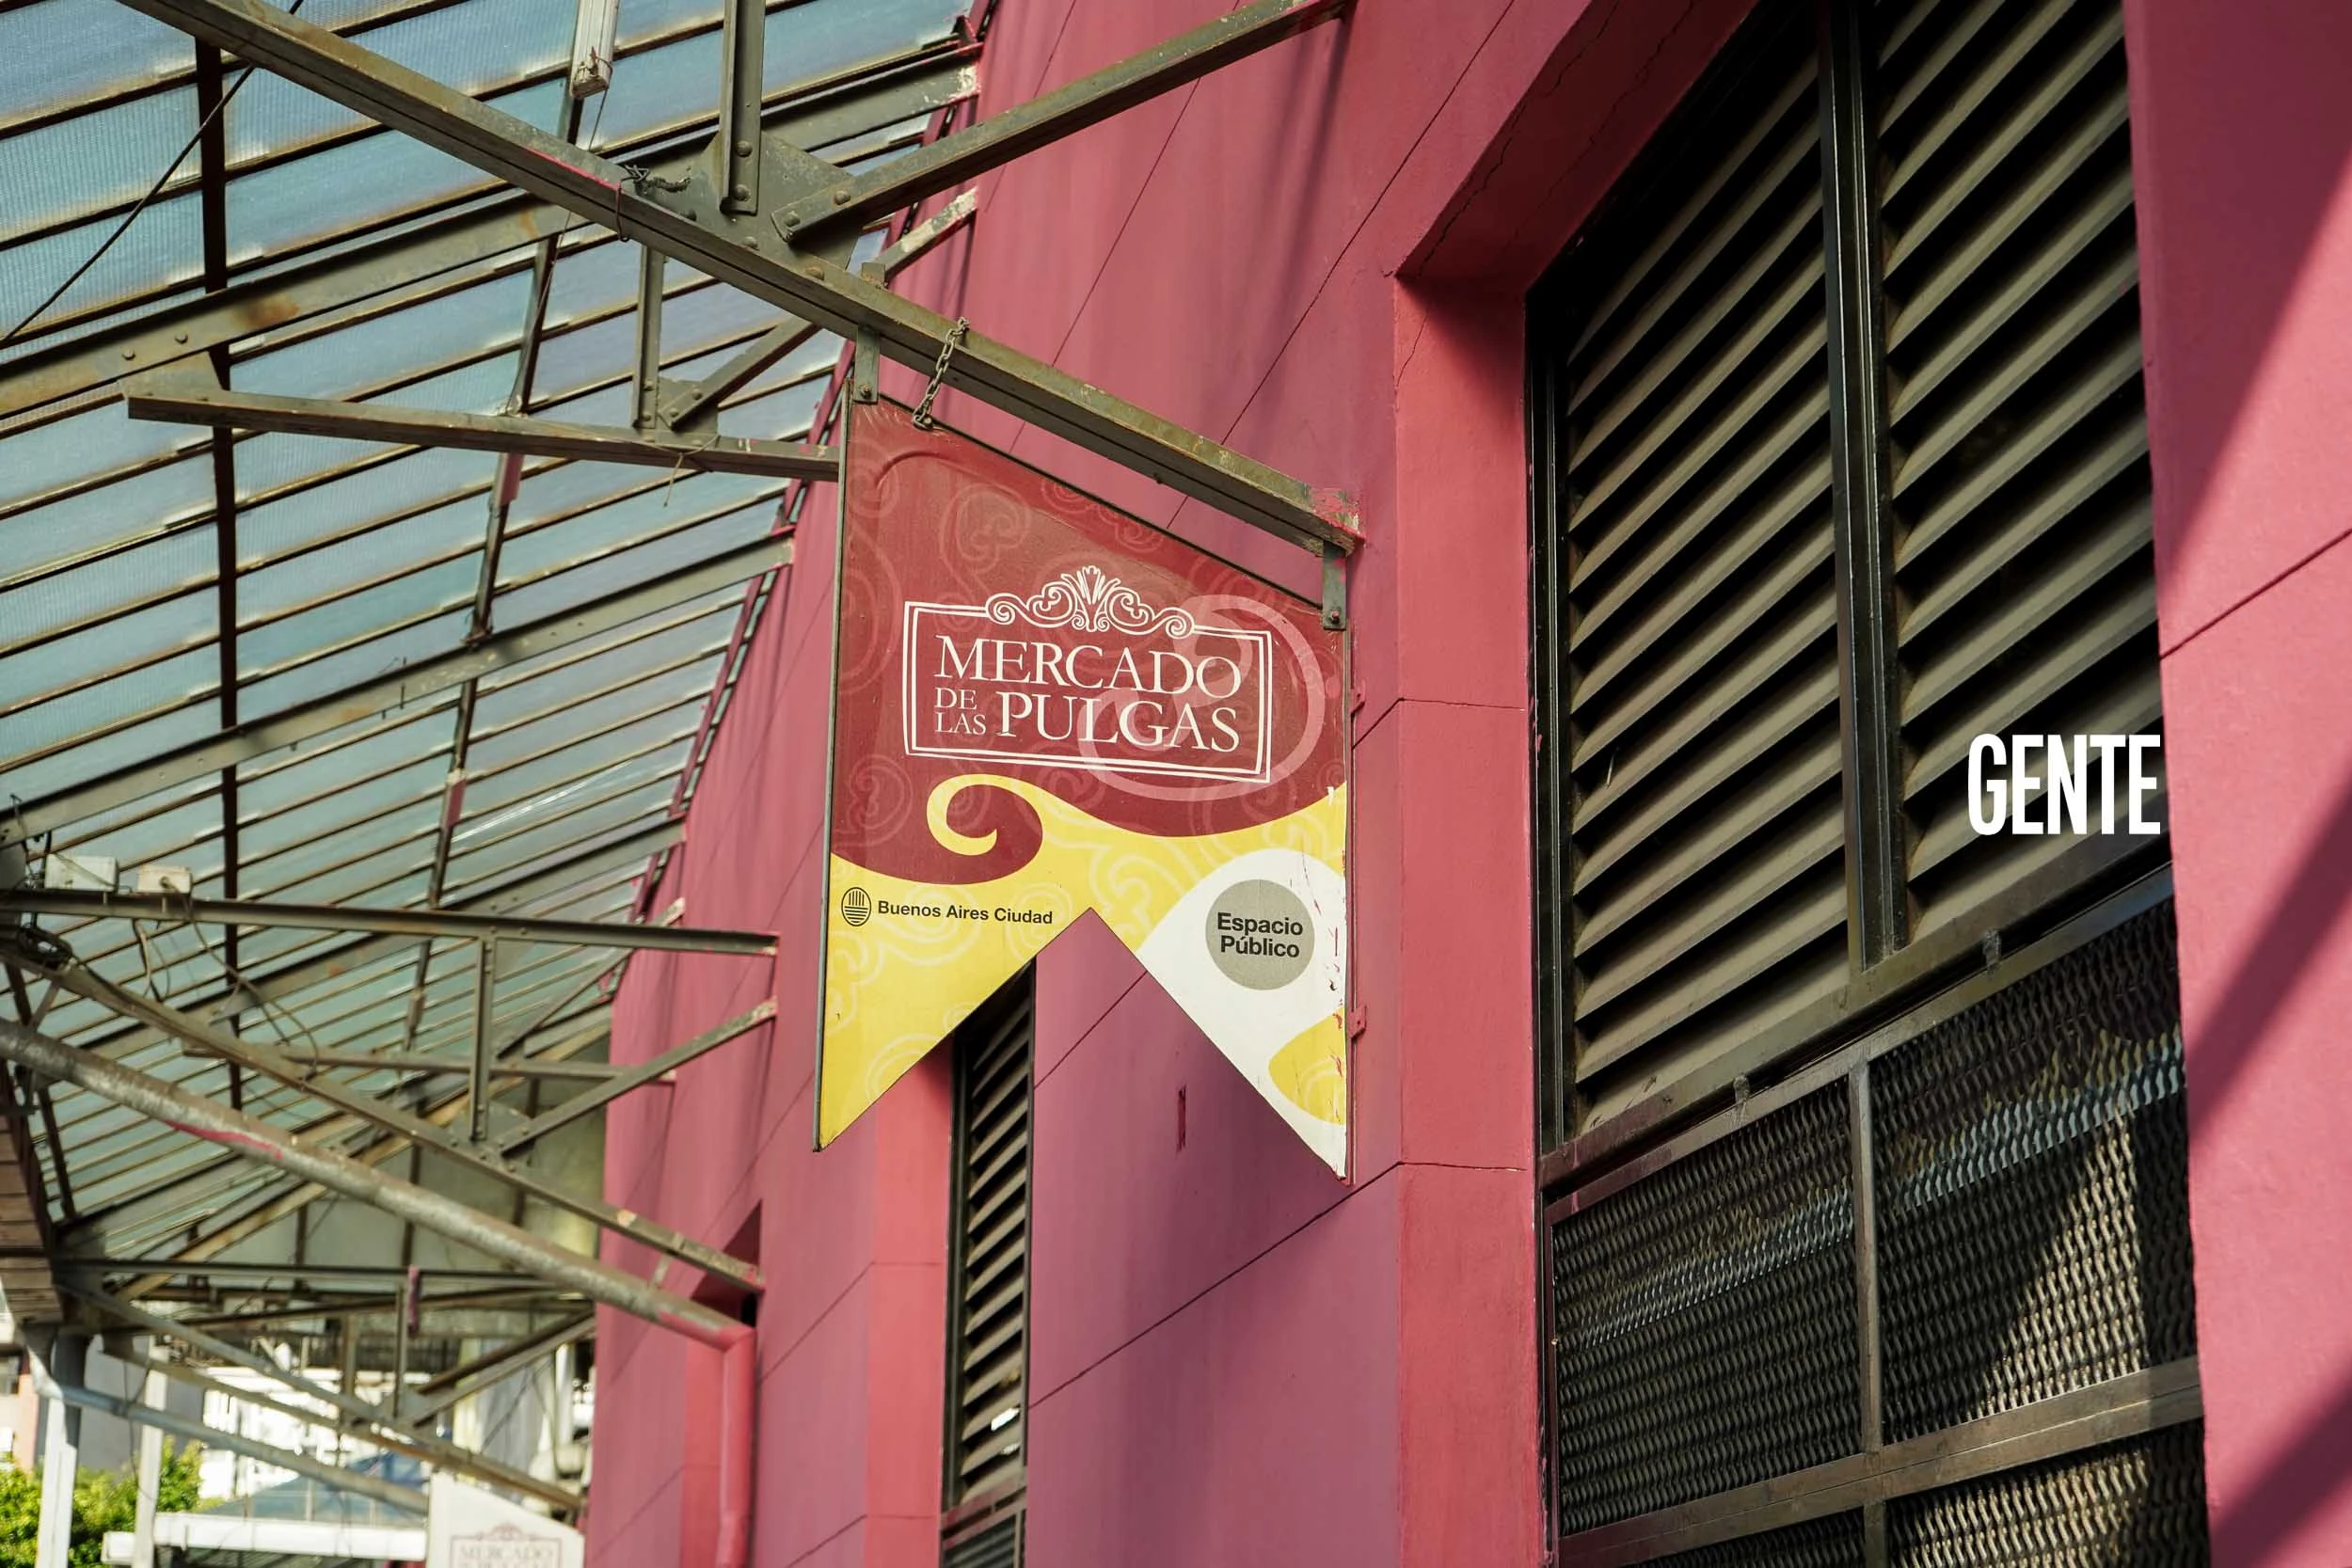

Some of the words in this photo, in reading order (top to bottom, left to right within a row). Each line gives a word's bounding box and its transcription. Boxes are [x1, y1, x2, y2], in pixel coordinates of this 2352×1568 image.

[933, 635, 1242, 699] MERCADO
[934, 688, 977, 712] DE
[934, 712, 987, 736] LAS
[996, 691, 1241, 752] PULGAS
[878, 899, 942, 919] Buenos
[946, 903, 989, 922] Aires
[993, 906, 1054, 926] Ciudad
[1216, 911, 1304, 938] Espacio
[1220, 935, 1301, 958] Público
